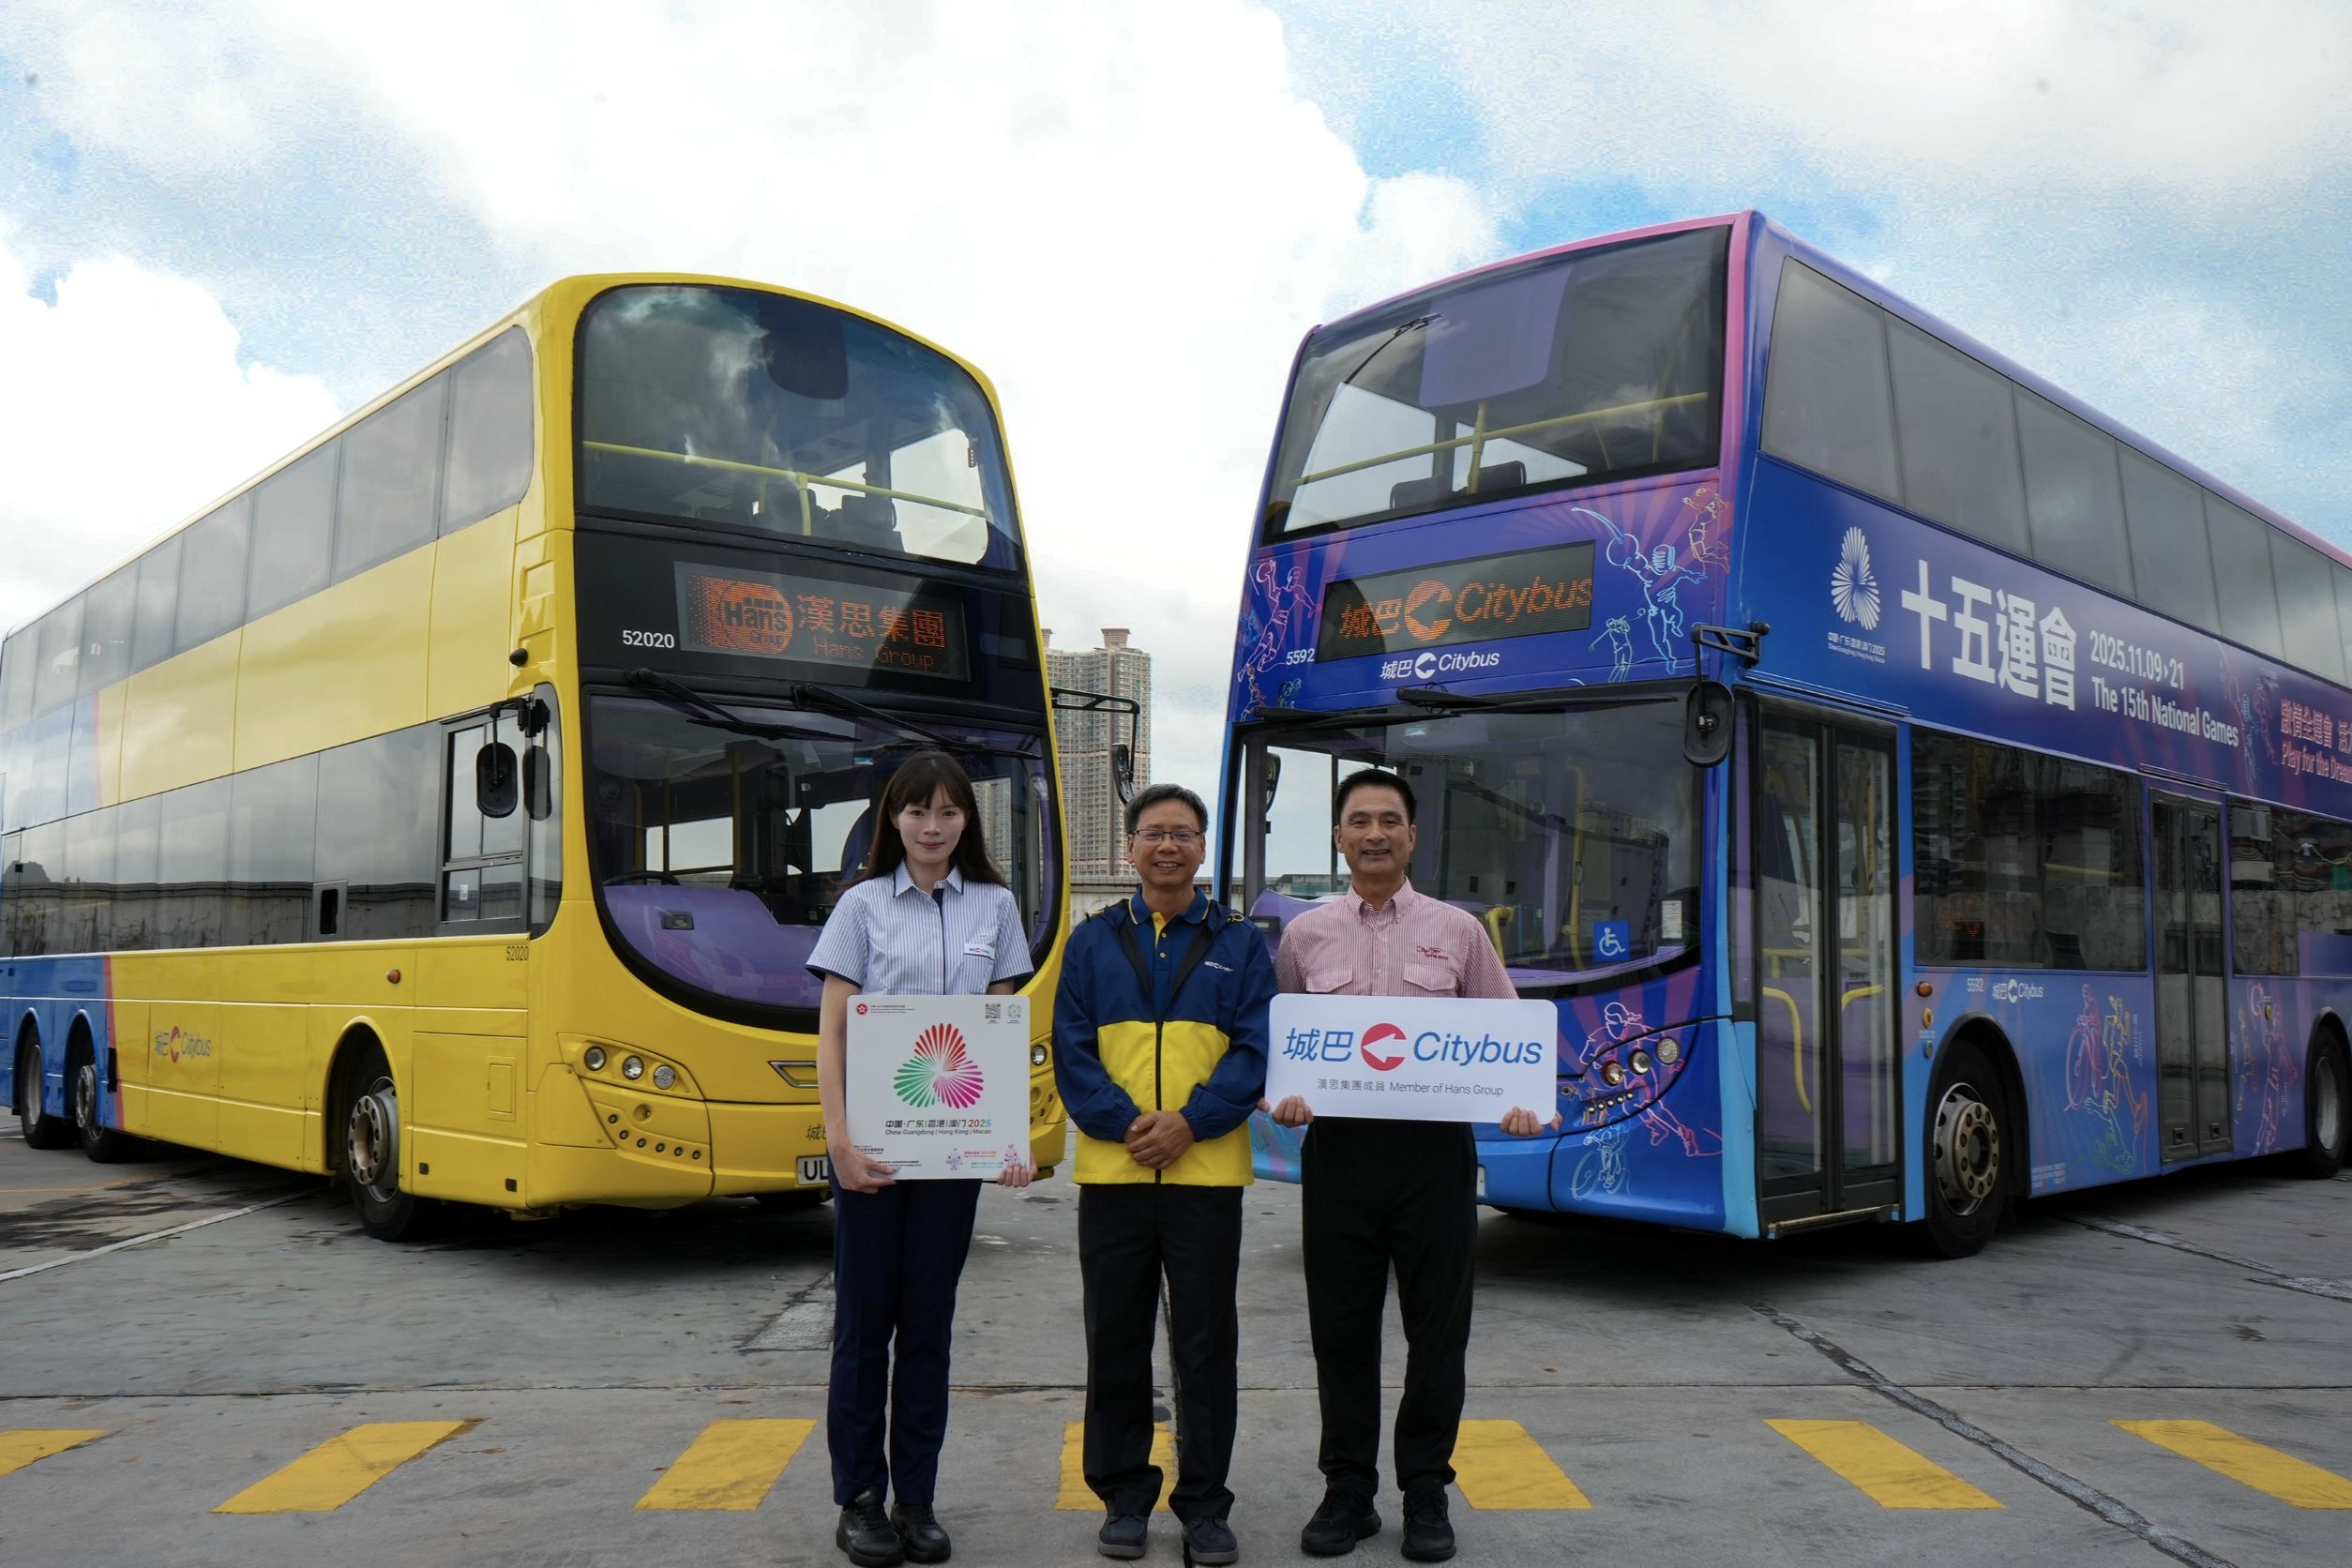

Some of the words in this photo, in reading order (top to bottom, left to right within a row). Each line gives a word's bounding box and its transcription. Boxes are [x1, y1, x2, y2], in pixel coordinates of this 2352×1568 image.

[724, 599, 789, 633] Hans
[797, 593, 946, 649] 漢思集團
[1339, 598, 1401, 639] 城巴
[1455, 575, 1592, 624] Citybus
[622, 629, 675, 649] 52020
[1902, 559, 2077, 711] 十五運會
[814, 635, 864, 660] Hans
[874, 643, 936, 672] Group
[1286, 647, 1315, 666] 5592
[1380, 659, 1413, 680] 城巴
[1438, 650, 1500, 671] Citybus
[2091, 676, 2119, 713] The
[2121, 686, 2150, 723] 15th
[2151, 695, 2201, 736] National
[2202, 711, 2239, 747] Games
[2282, 740, 2301, 775] Play
[506, 945, 529, 960] 52020
[1967, 978, 1984, 992] 5592
[2018, 983, 2043, 1000] Citybus
[181, 1032, 211, 1059] Citybus
[1282, 1028, 1354, 1063] 城巴
[1413, 1032, 1544, 1066] Citybus
[1317, 1078, 1385, 1092] 漢思集團成員
[1390, 1082, 1430, 1093] Member
[1432, 1083, 1444, 1093] of
[1445, 1084, 1470, 1094] Hans
[1472, 1085, 1503, 1096] Group
[968, 1119, 991, 1128] 2025
